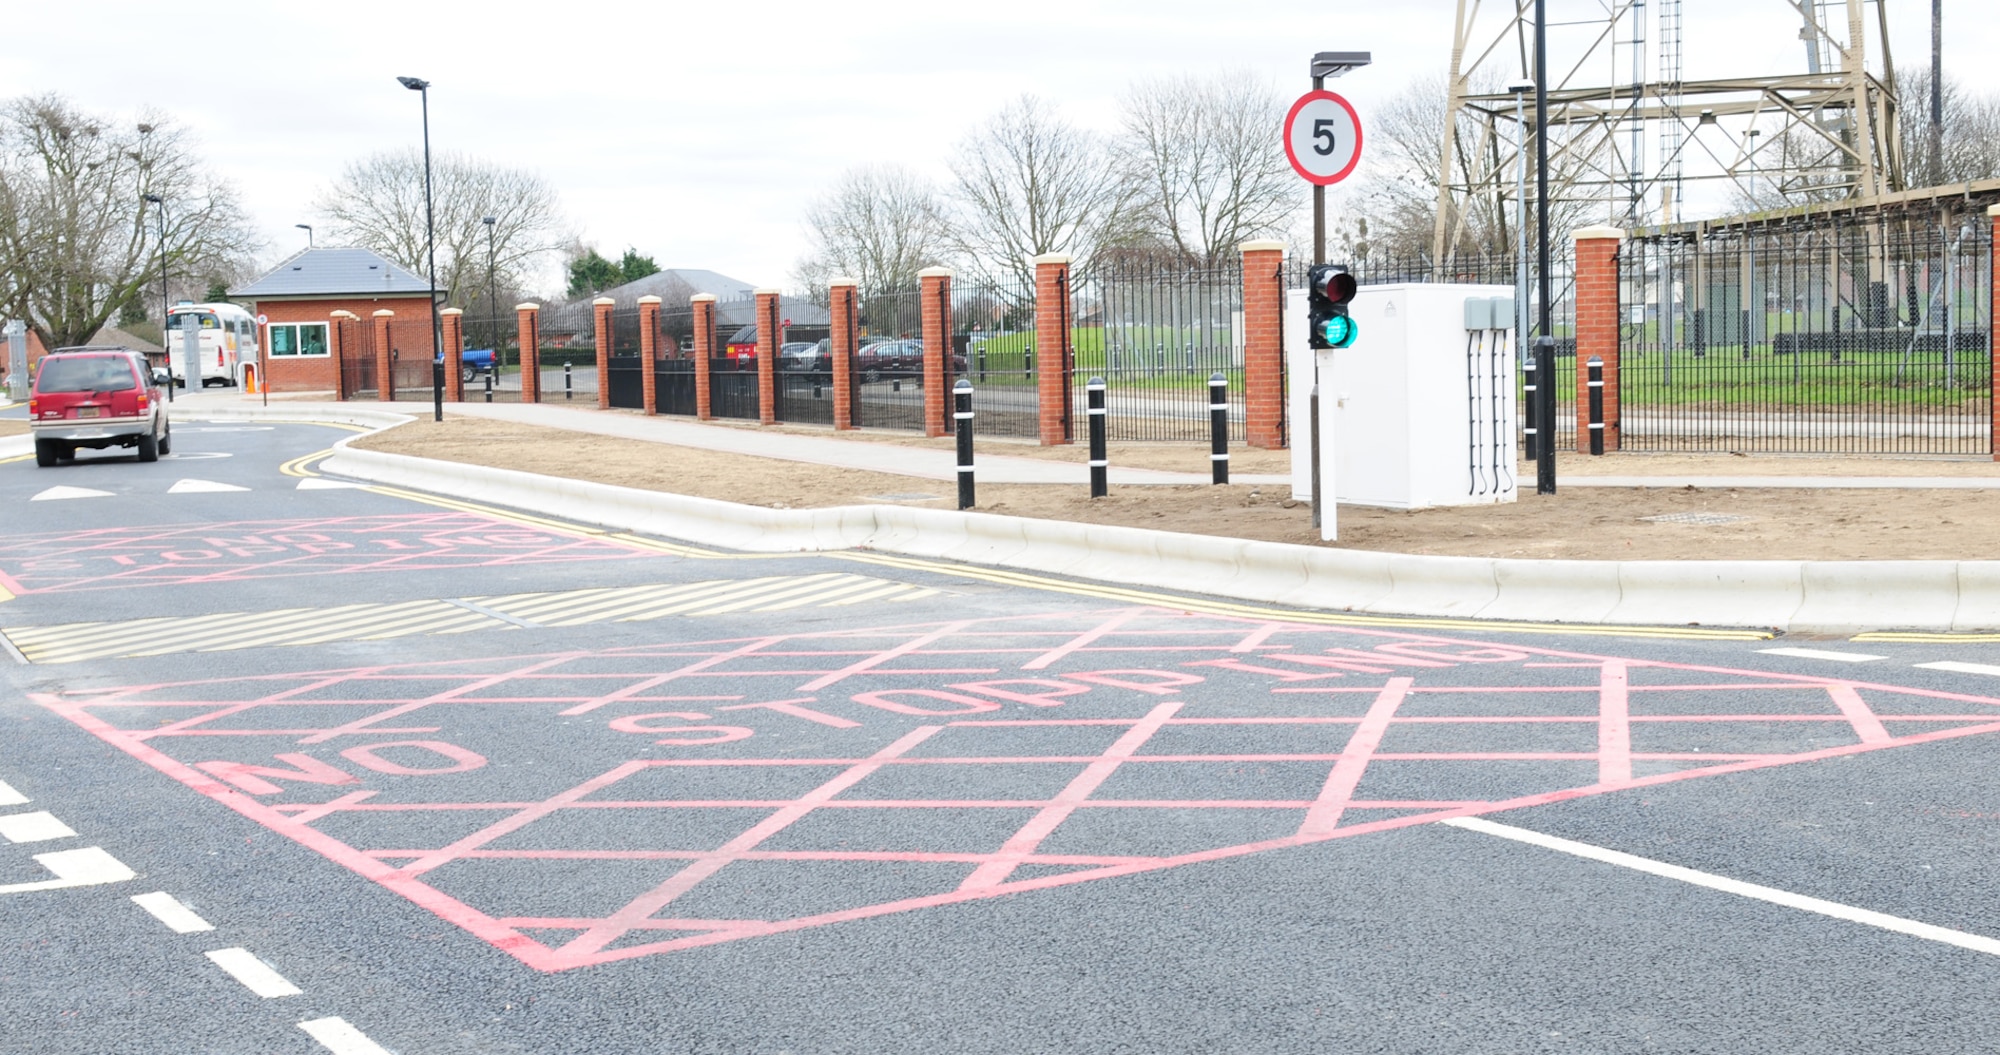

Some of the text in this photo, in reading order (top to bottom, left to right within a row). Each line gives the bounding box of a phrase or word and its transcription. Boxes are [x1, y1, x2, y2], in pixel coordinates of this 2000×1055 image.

[1313, 119, 1335, 156] 5
[20, 532, 553, 571] STOPPING
[202, 533, 332, 547] NO
[195, 642, 1530, 795] NO STOPPING
